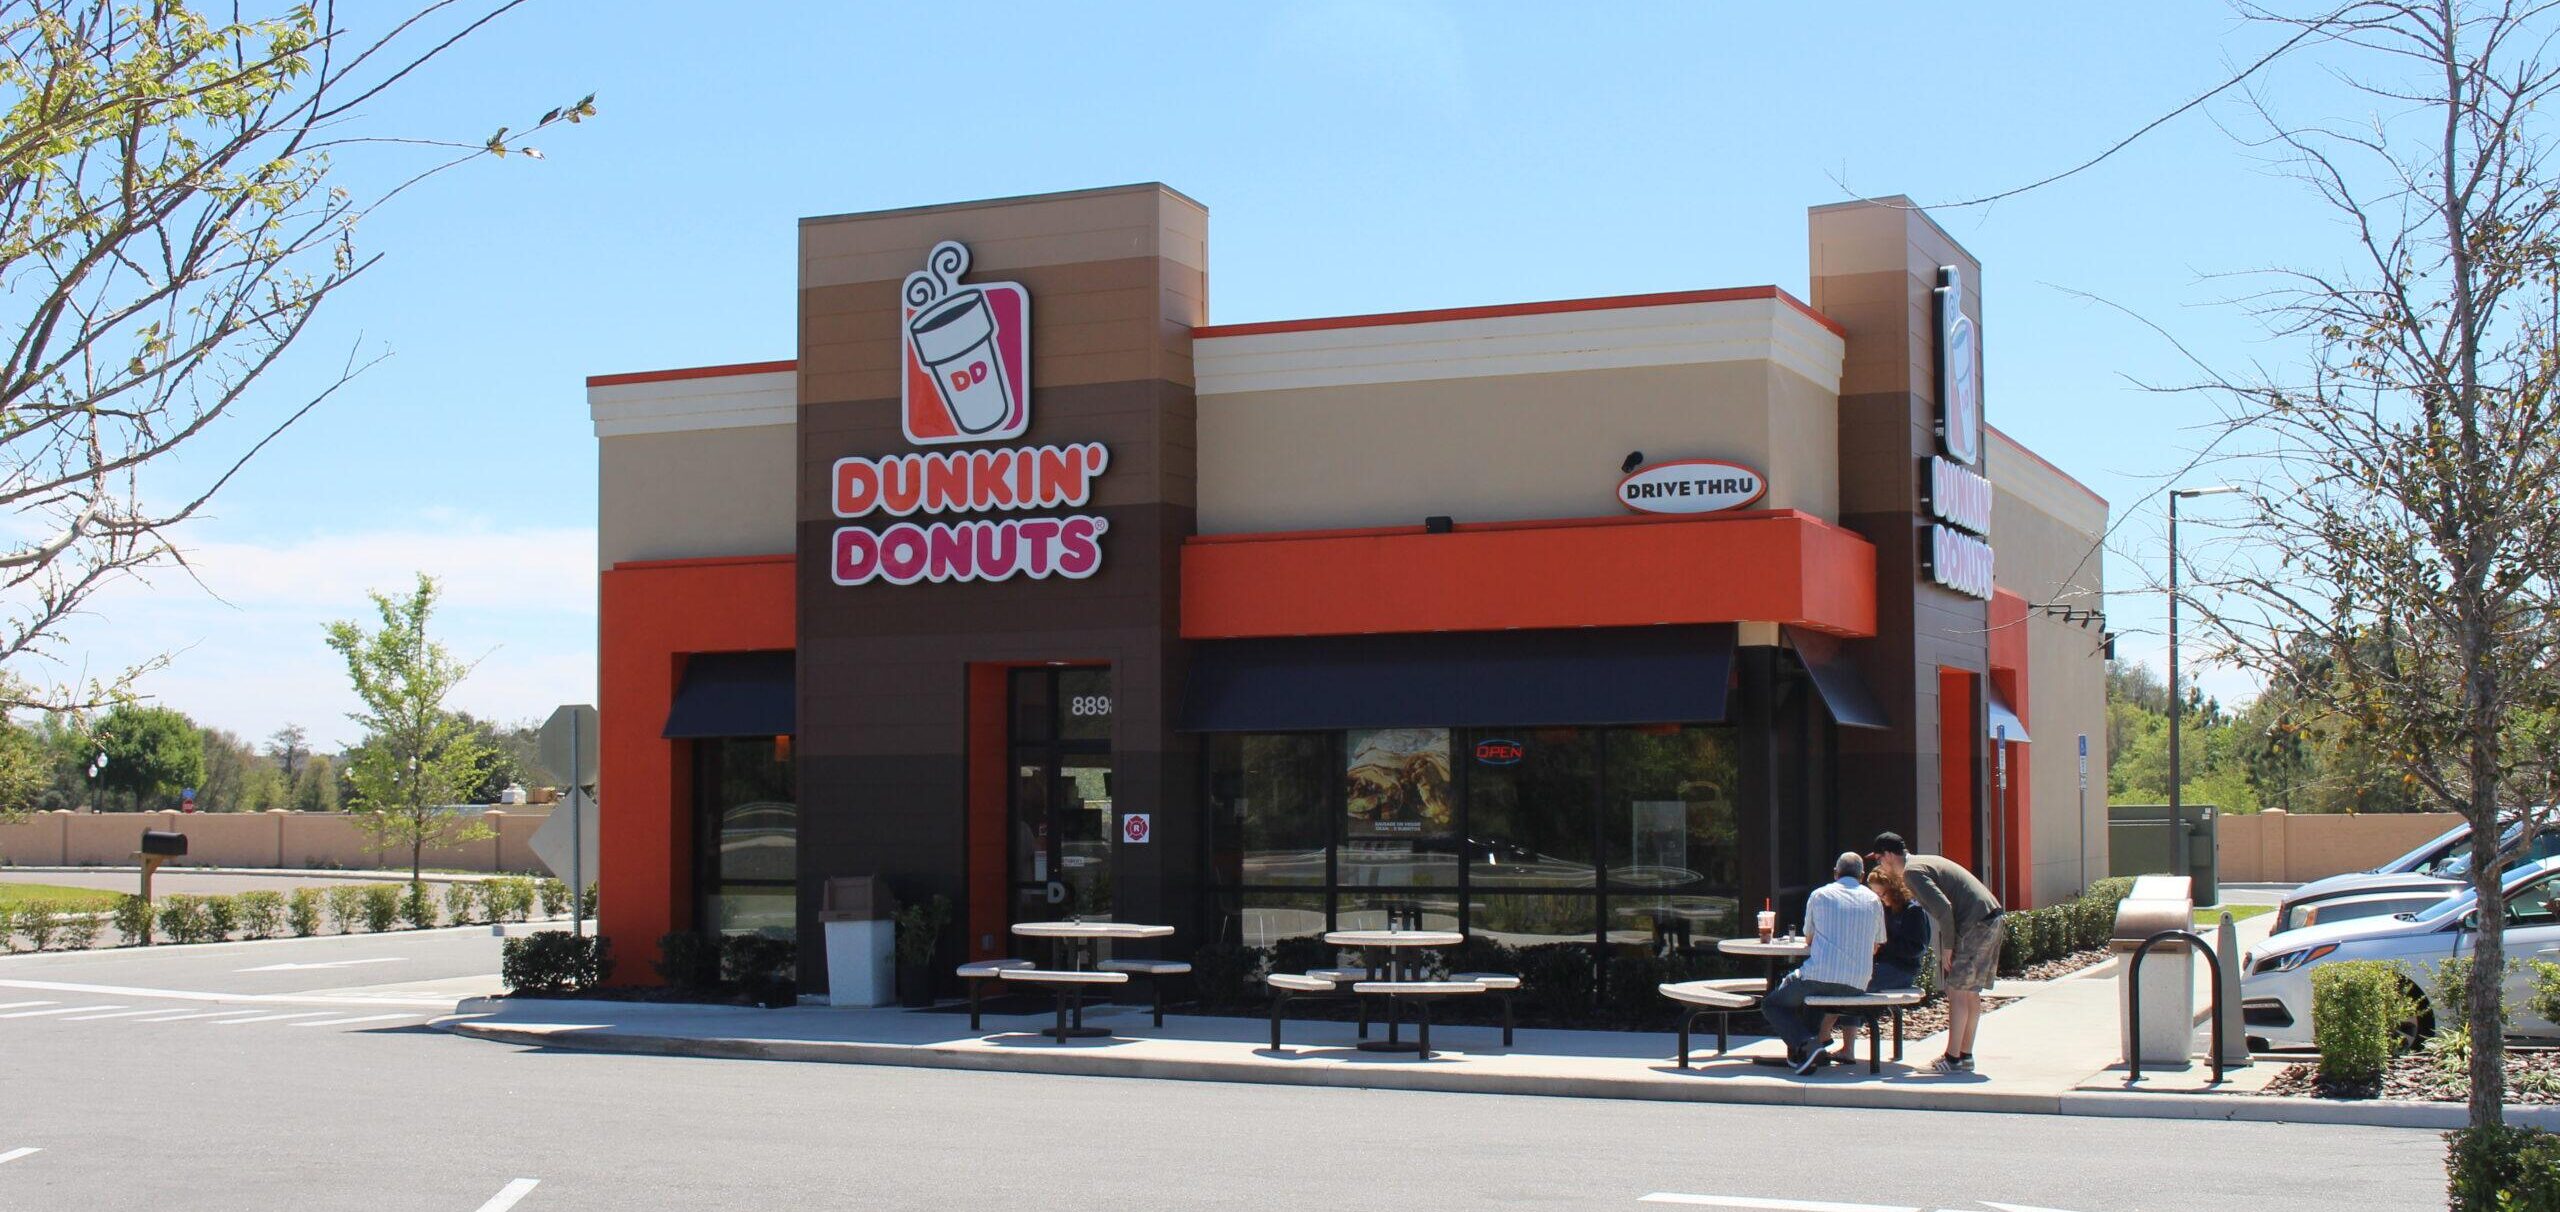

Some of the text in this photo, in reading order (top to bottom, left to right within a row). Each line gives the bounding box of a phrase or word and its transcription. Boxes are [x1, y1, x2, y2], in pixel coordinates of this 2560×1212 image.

[950, 360, 988, 392] DD
[837, 446, 1101, 514] DUNKIN'
[1627, 478, 1753, 499] DRIVE THRU
[836, 518, 1097, 581] DONUTS
[1072, 696, 1112, 715] 889
[1476, 745, 1523, 758] OPEN
